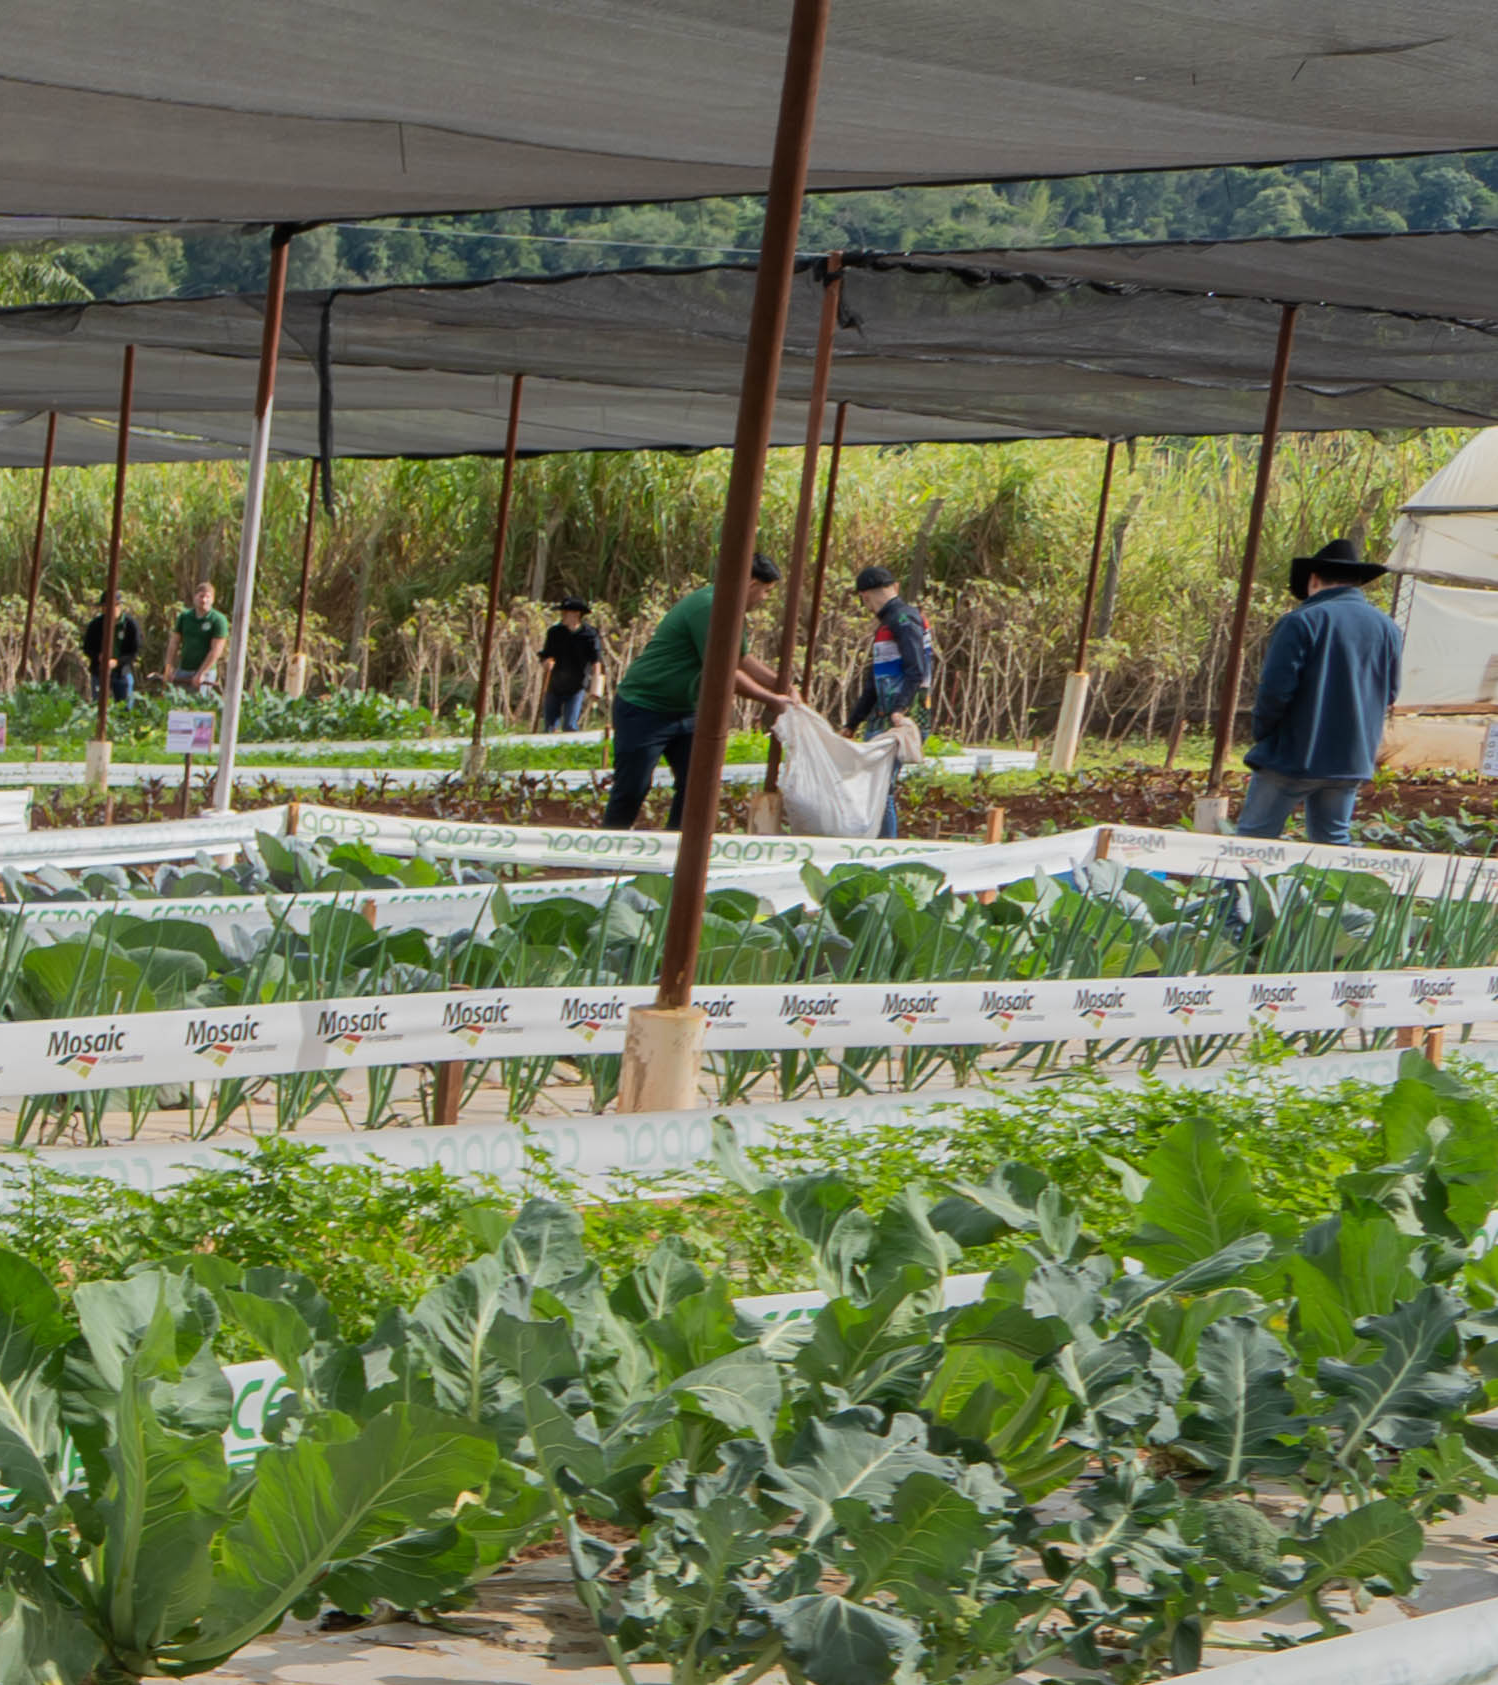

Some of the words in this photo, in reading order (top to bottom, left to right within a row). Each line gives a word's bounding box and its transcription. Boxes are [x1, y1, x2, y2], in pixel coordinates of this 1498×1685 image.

[442, 998, 509, 1027] Mosaic
[560, 995, 626, 1022] Mosaic
[779, 992, 841, 1017] Mosaic
[881, 990, 940, 1014] Mosaic
[979, 988, 1035, 1012] Mosaic
[185, 1014, 260, 1046] Mosaic
[316, 1005, 388, 1036] Mosaic
[47, 1025, 126, 1056] Mosaic
